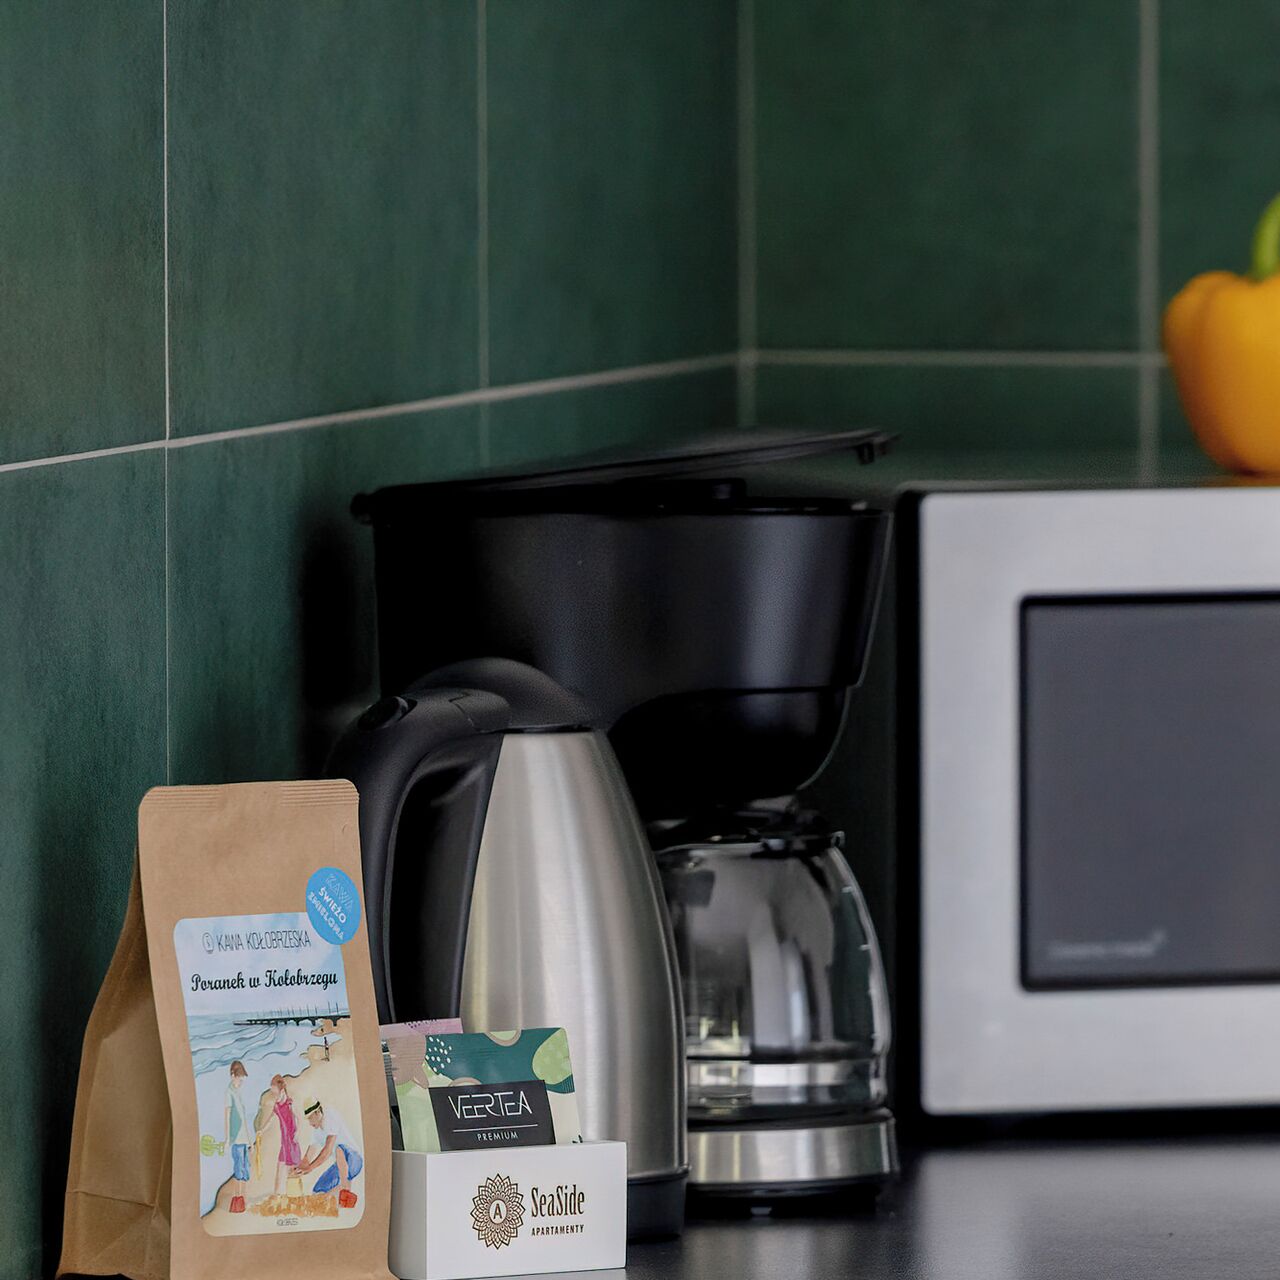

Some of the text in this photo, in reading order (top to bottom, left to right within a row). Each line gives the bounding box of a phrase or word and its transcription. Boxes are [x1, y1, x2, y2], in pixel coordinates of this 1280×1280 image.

[318, 886, 347, 924] ŚWIEŻO
[217, 931, 312, 952] KAWA KOŁOBRZESKA
[191, 968, 338, 991] Poranek w Kołobrzegu
[448, 1091, 533, 1119] VEERTEA
[477, 1131, 518, 1141] PREMIUM
[493, 1203, 502, 1219] A
[531, 1184, 585, 1218] SeaSide
[531, 1224, 584, 1236] APARTAMENTY
